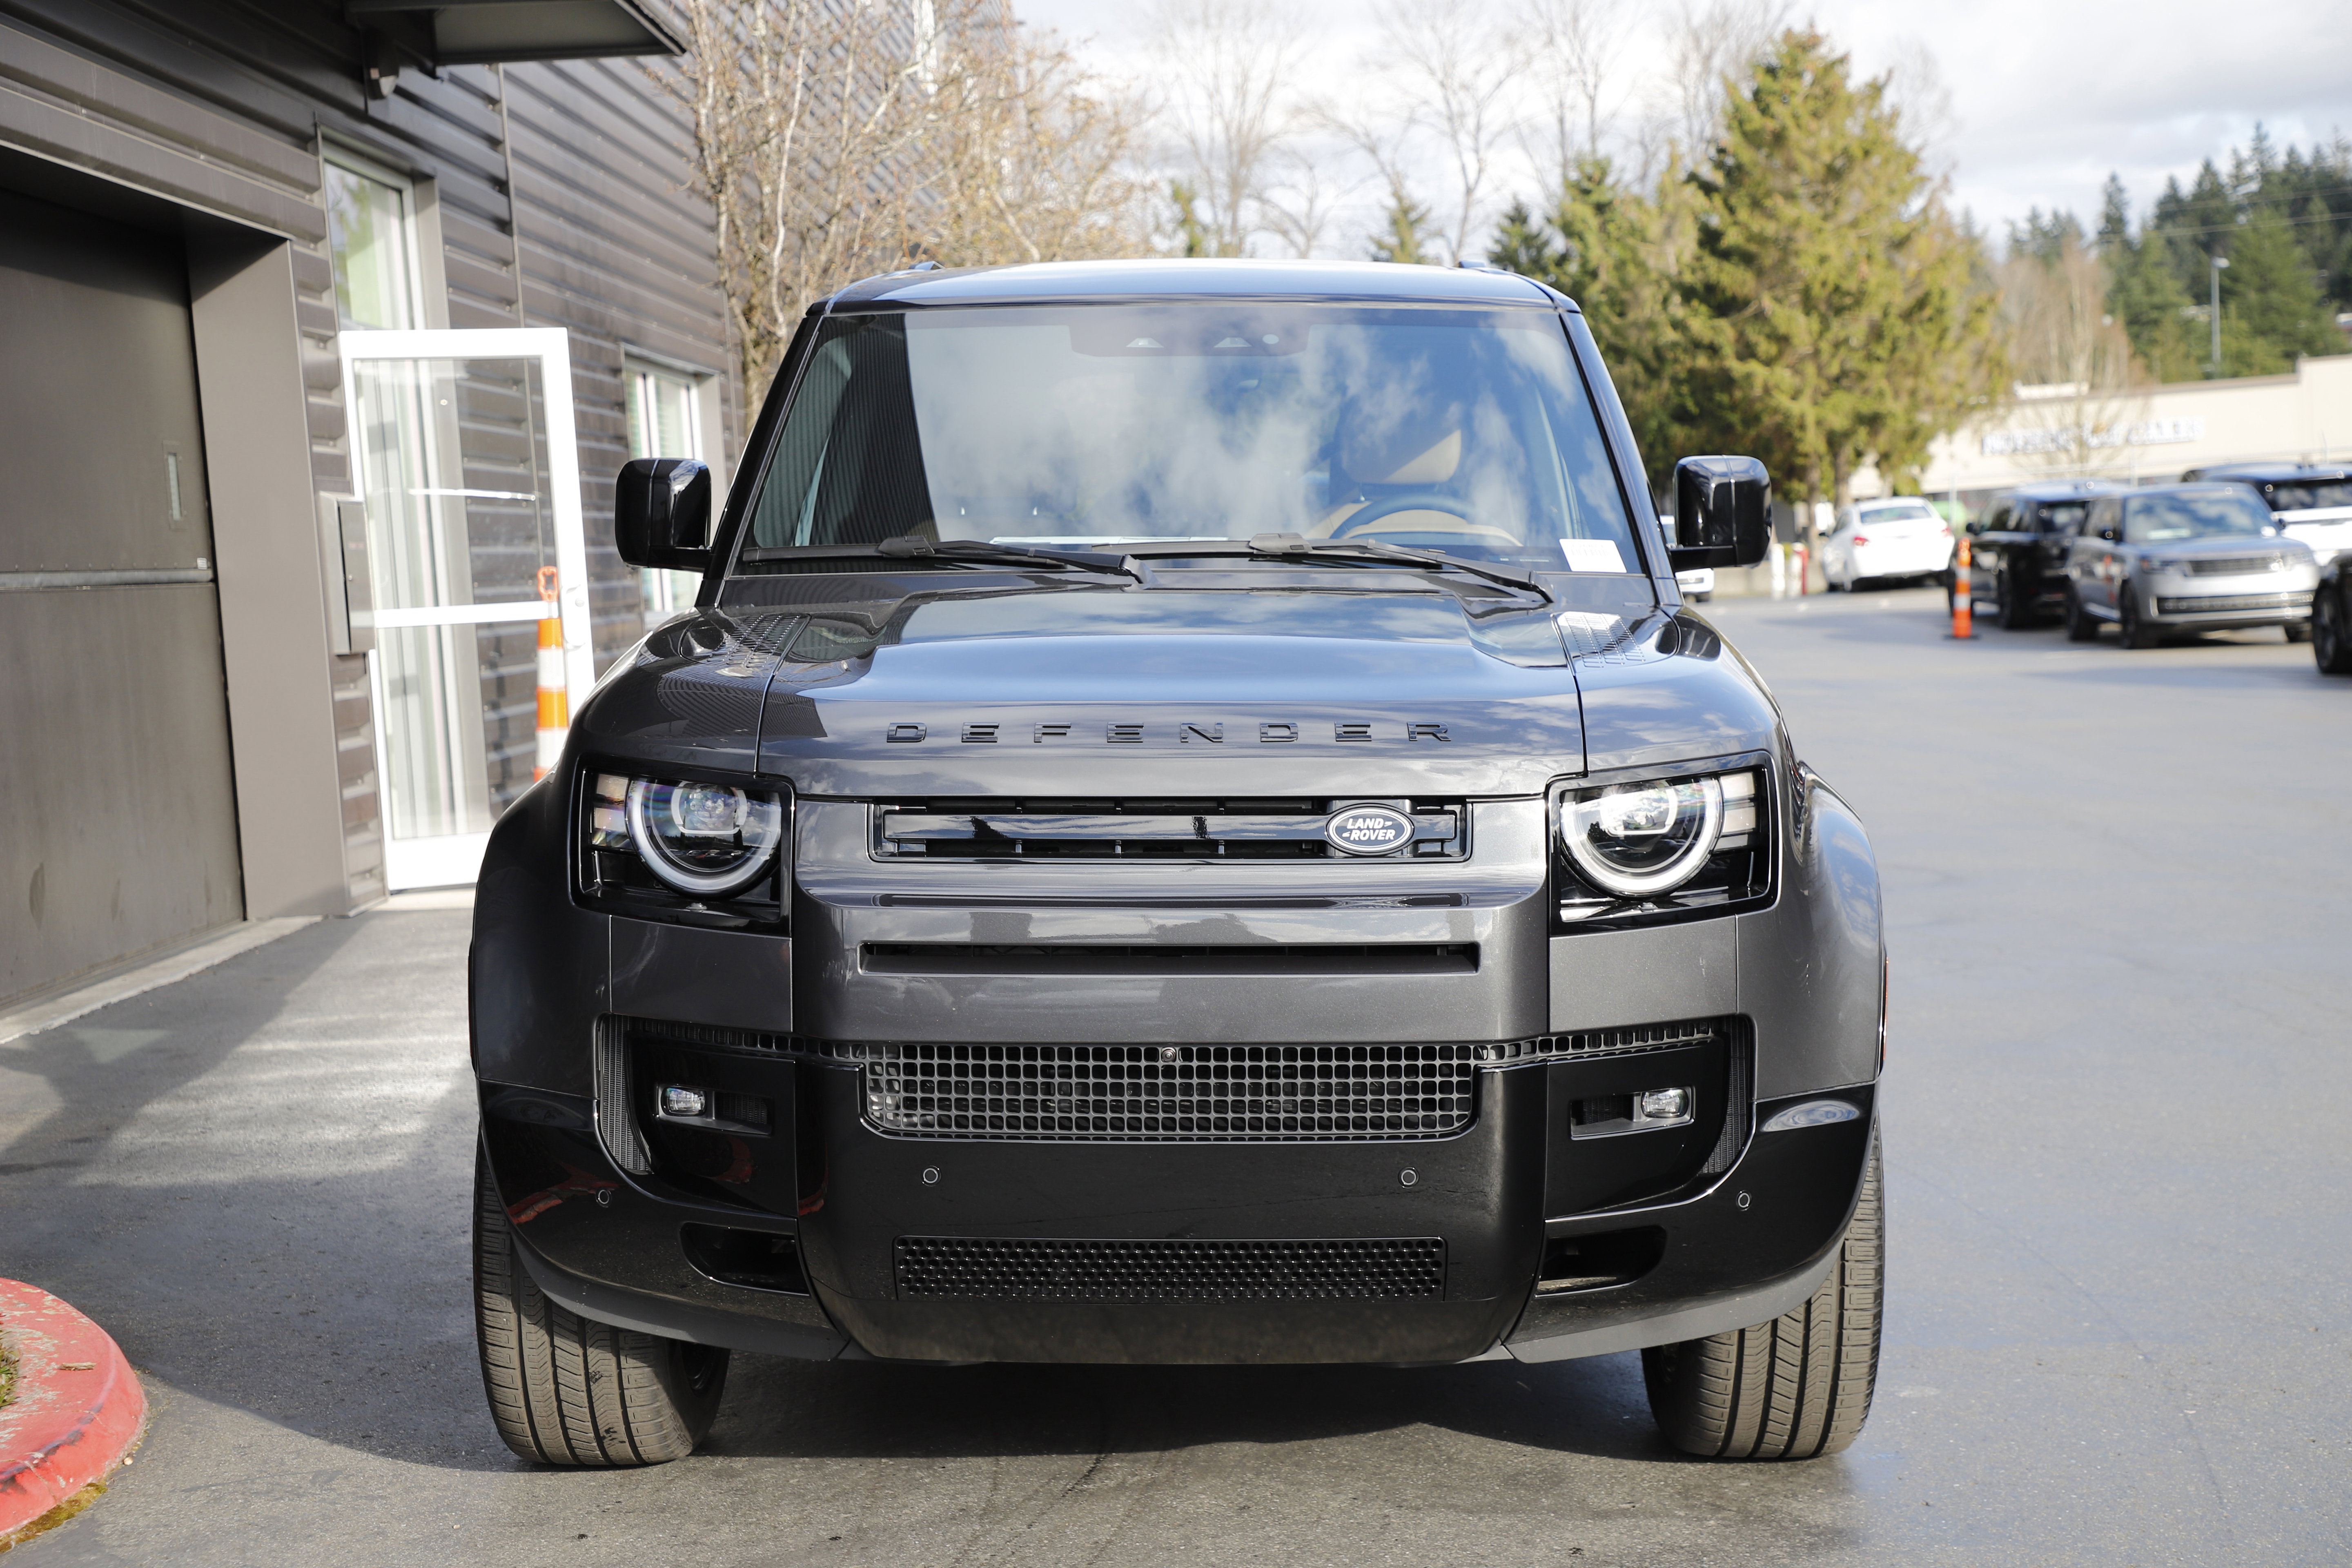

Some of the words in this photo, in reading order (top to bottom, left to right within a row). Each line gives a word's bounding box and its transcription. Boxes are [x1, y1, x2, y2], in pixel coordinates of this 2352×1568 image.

[886, 721, 1452, 743] DEFENDER
[1346, 818, 1384, 829] LAND
[1350, 829, 1396, 840] ROVER
